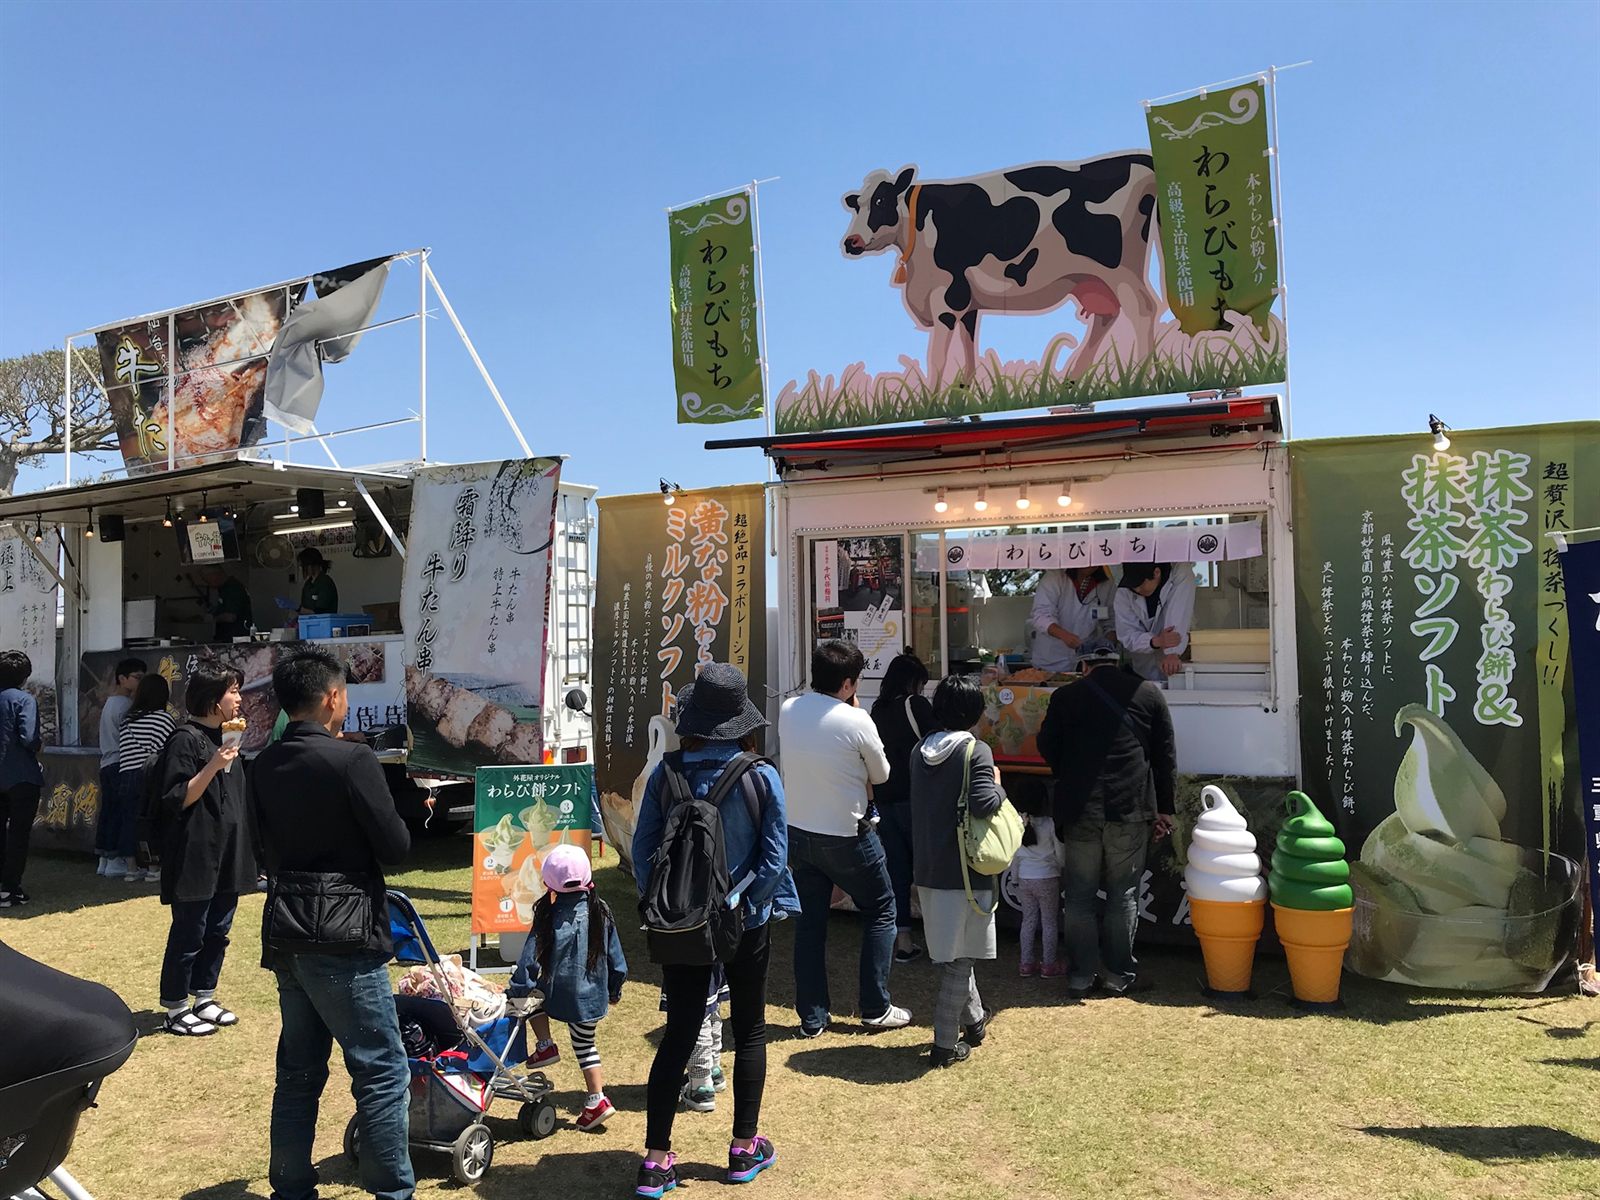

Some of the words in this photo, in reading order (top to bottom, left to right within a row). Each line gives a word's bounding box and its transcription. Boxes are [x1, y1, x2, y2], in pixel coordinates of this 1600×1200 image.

[1167, 182, 1195, 307] 高級宇治抹茶使用
[1246, 173, 1267, 285] 本わらび粉入り
[678, 264, 694, 367] 高級宇治抹茶使用
[699, 239, 732, 390] わらびもち
[738, 263, 751, 357] 本わらび粉入り
[450, 487, 480, 582] 霜降り
[568, 535, 586, 543] HINO
[1006, 536, 1146, 561] わらびもち
[1401, 453, 1468, 720] 抹茶ソフト
[1466, 448, 1534, 727] 抹茶わらび餅&
[415, 552, 446, 677] 牛たん串
[487, 567, 504, 656] 特上牛たん串
[506, 566, 521, 625] 牛たん串
[657, 508, 690, 718] ミルクソフト
[733, 513, 749, 672] 超絶品コラボレーショ
[487, 782, 582, 799] わらび餅ソフト
